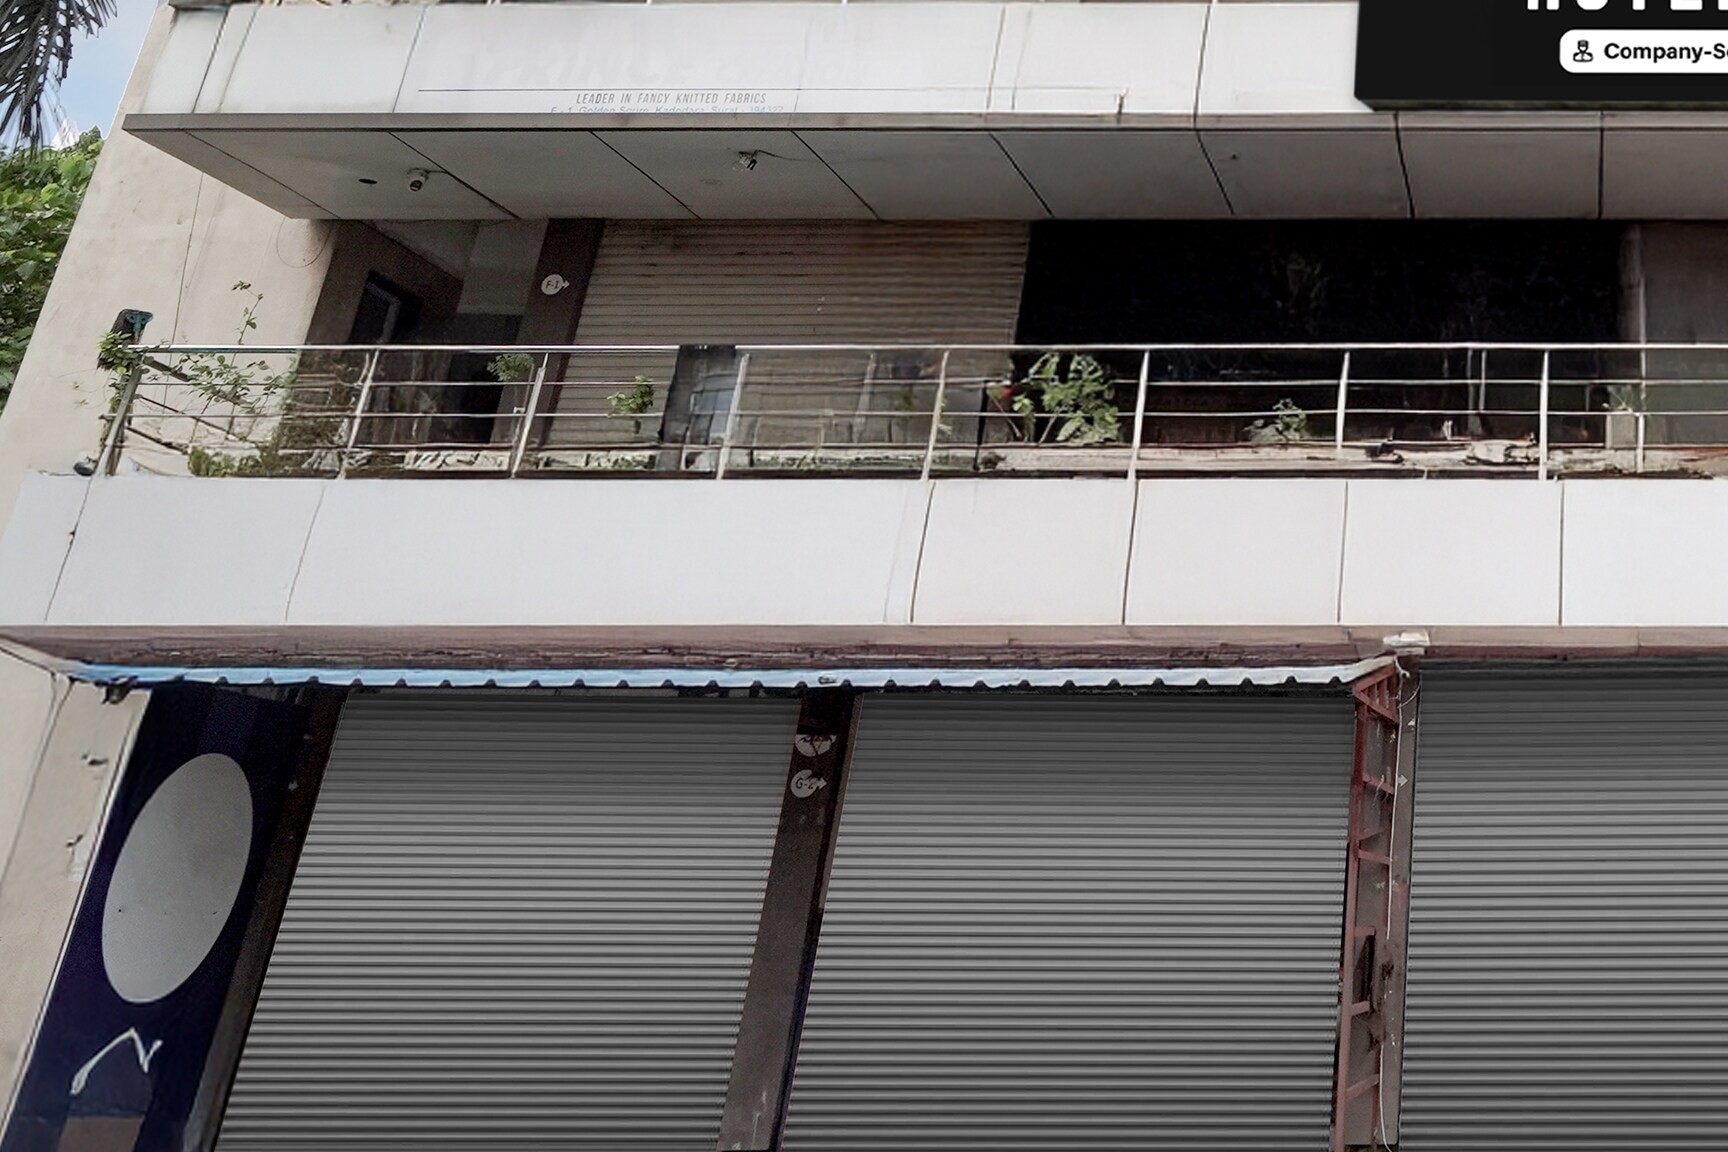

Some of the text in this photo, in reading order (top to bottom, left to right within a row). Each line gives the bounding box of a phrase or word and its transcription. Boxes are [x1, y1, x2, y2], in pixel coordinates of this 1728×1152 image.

[575, 93, 767, 104] LEADER IN FANCY KNITTED FABRICS
[545, 280, 560, 289] F-1
